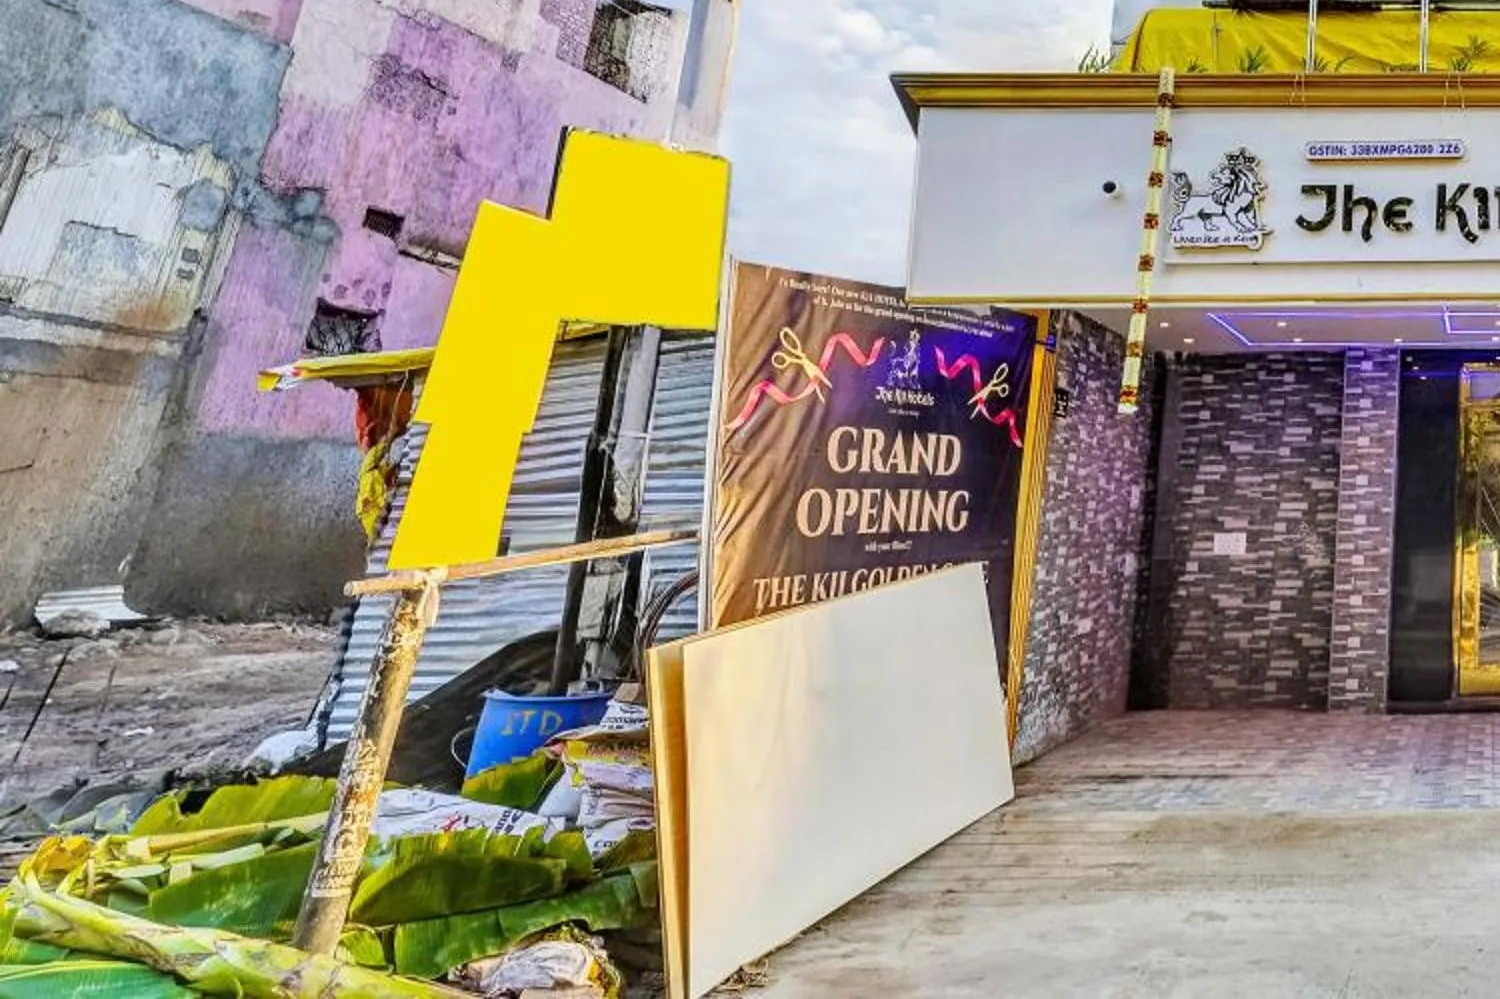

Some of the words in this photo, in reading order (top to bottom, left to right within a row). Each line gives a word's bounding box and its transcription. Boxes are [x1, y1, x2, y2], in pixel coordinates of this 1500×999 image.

[827, 426, 962, 476] GRAND
[796, 488, 969, 538] OPENING
[753, 574, 807, 612] THE
